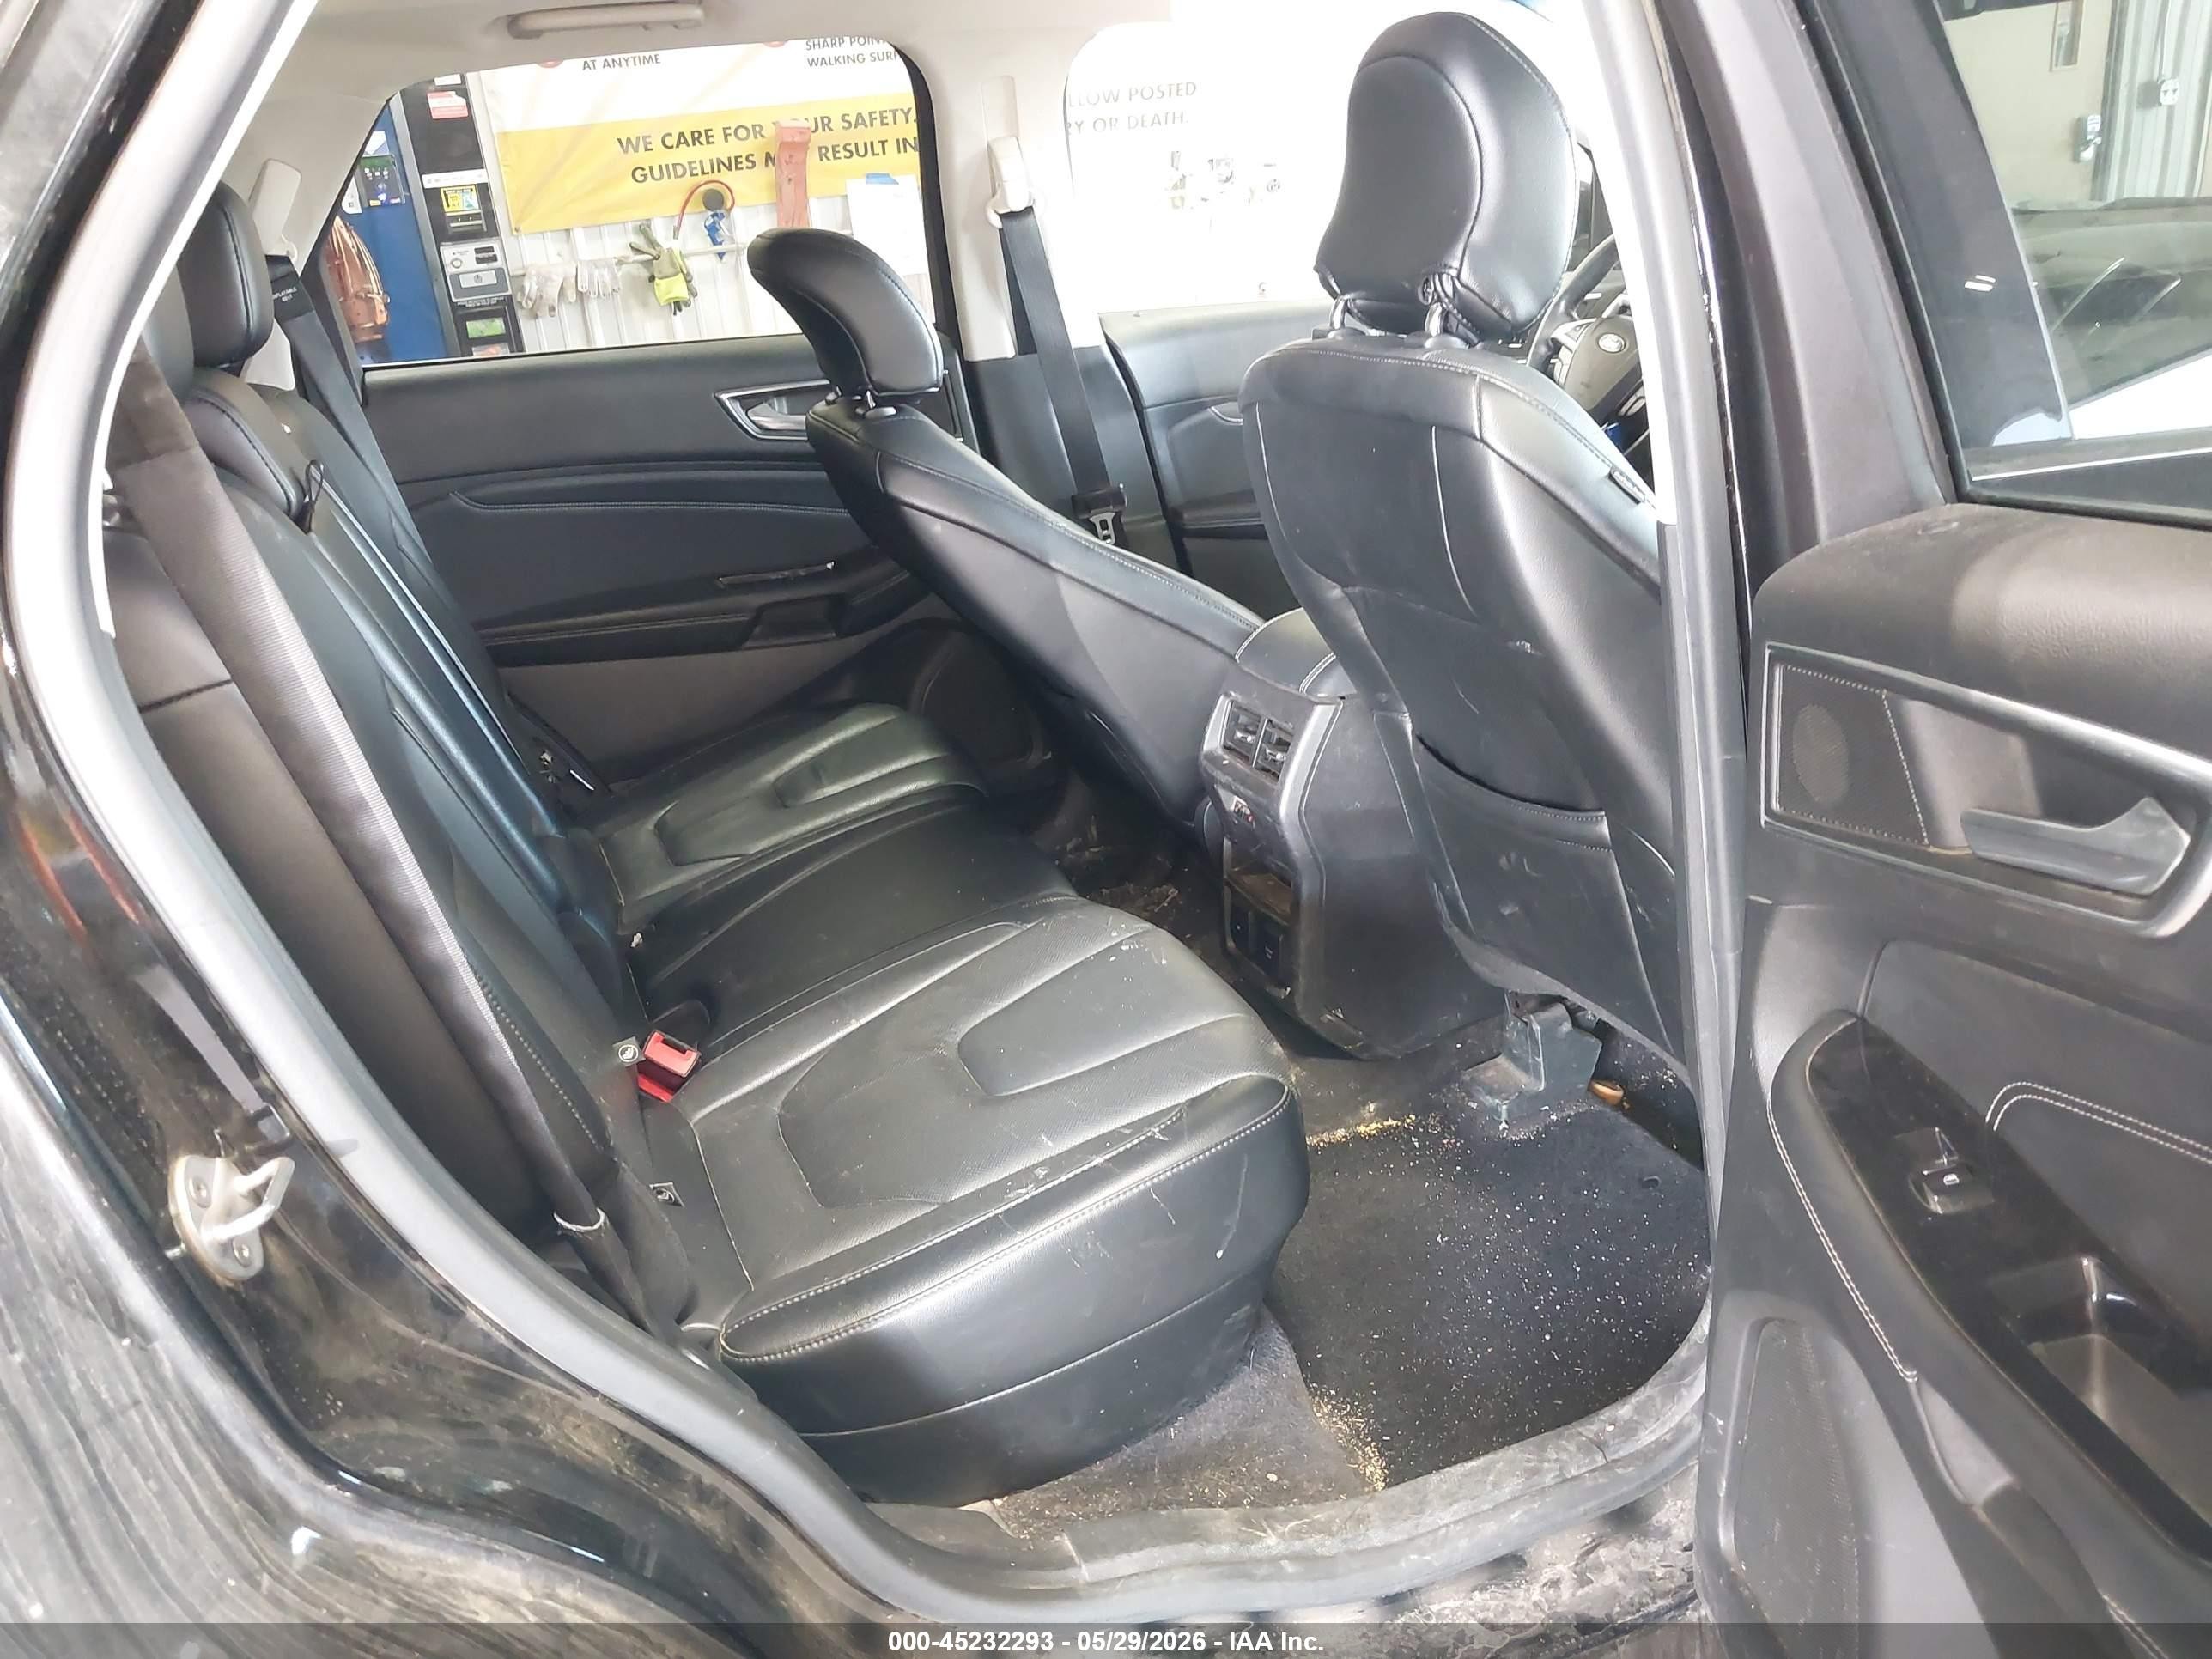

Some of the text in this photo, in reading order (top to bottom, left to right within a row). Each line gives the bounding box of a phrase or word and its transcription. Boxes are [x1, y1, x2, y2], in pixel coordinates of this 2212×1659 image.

[805, 37, 845, 51] SHARP
[582, 54, 661, 71] AT ANYTIME
[807, 53, 866, 67] WALKING
[617, 135, 653, 155] WE
[661, 128, 715, 149] CARE
[722, 124, 766, 143] FOR
[841, 107, 917, 130] SAFETY.
[1128, 82, 1197, 101] POSTED
[631, 153, 757, 184] GUIDELINES
[817, 139, 889, 161] RESULT
[1092, 117, 1119, 132] OR
[1128, 110, 1189, 130] DEATH.
